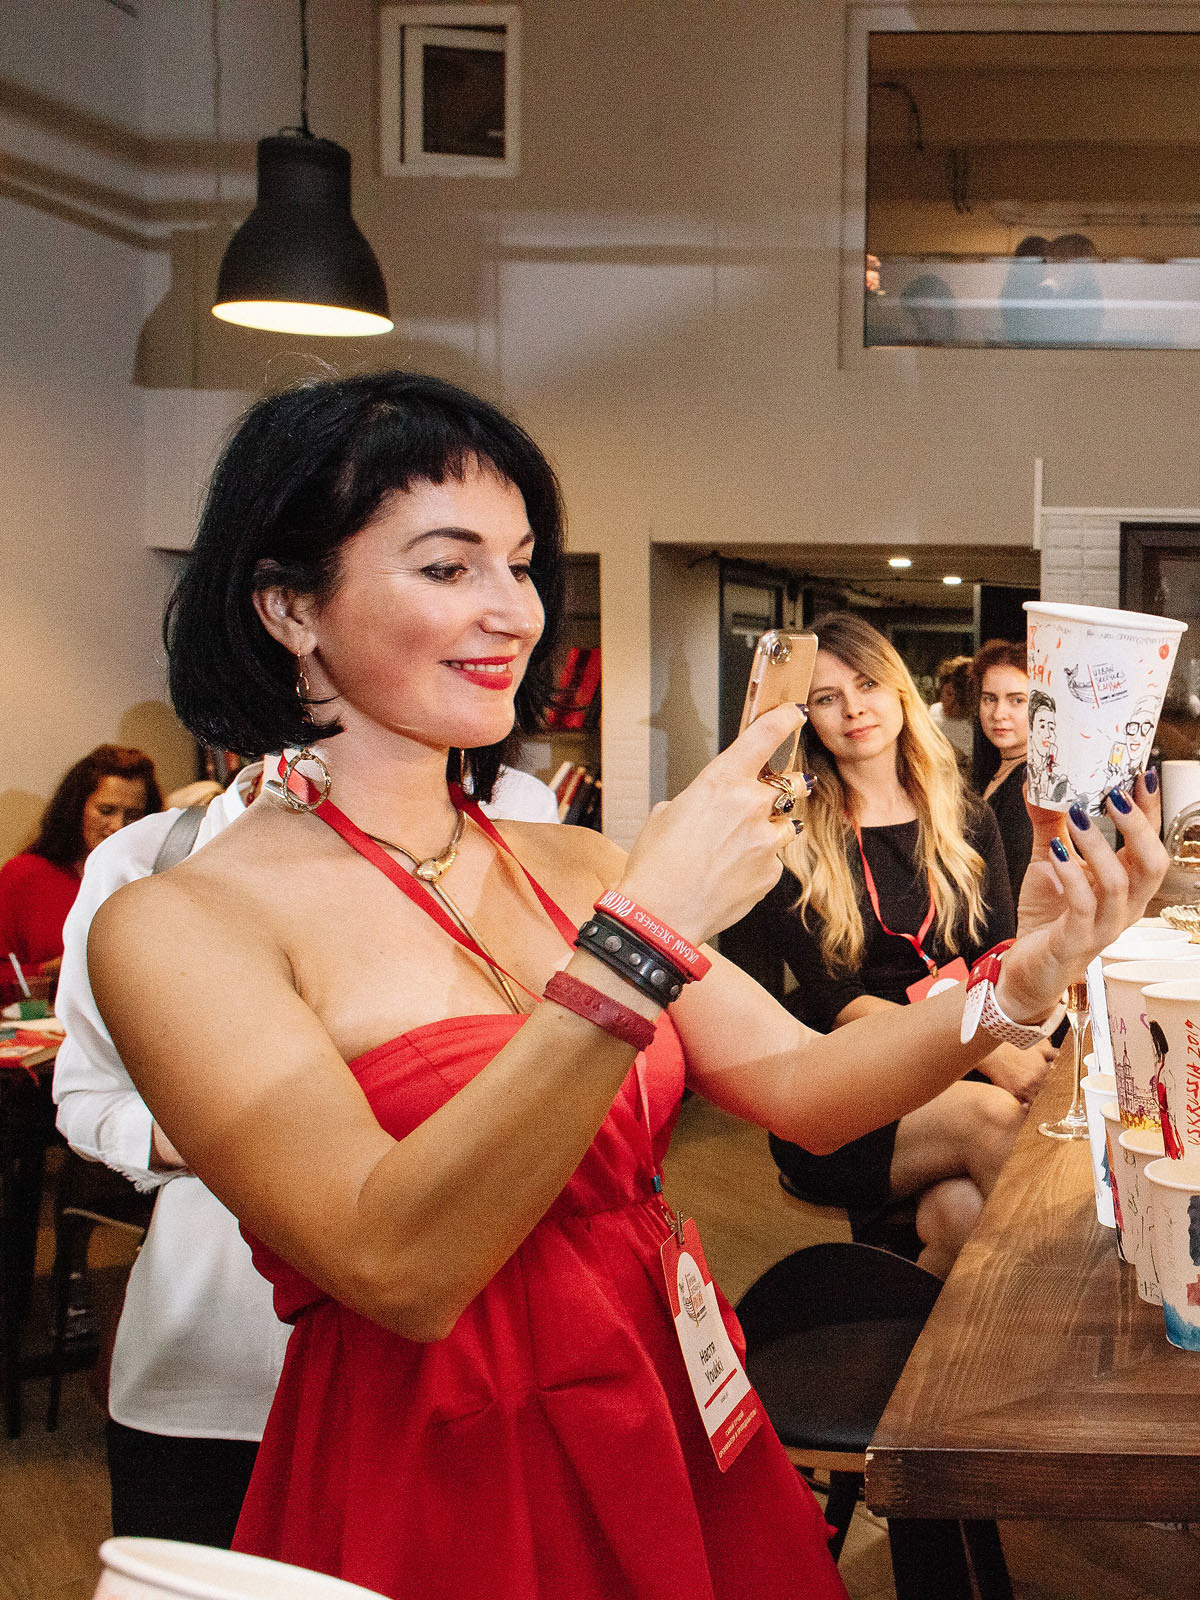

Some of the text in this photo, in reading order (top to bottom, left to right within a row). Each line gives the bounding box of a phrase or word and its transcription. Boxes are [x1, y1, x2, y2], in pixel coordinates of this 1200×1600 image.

[635, 911, 699, 964] URBAN SKETCHERS
[1185, 1019, 1200, 1058] 2019
